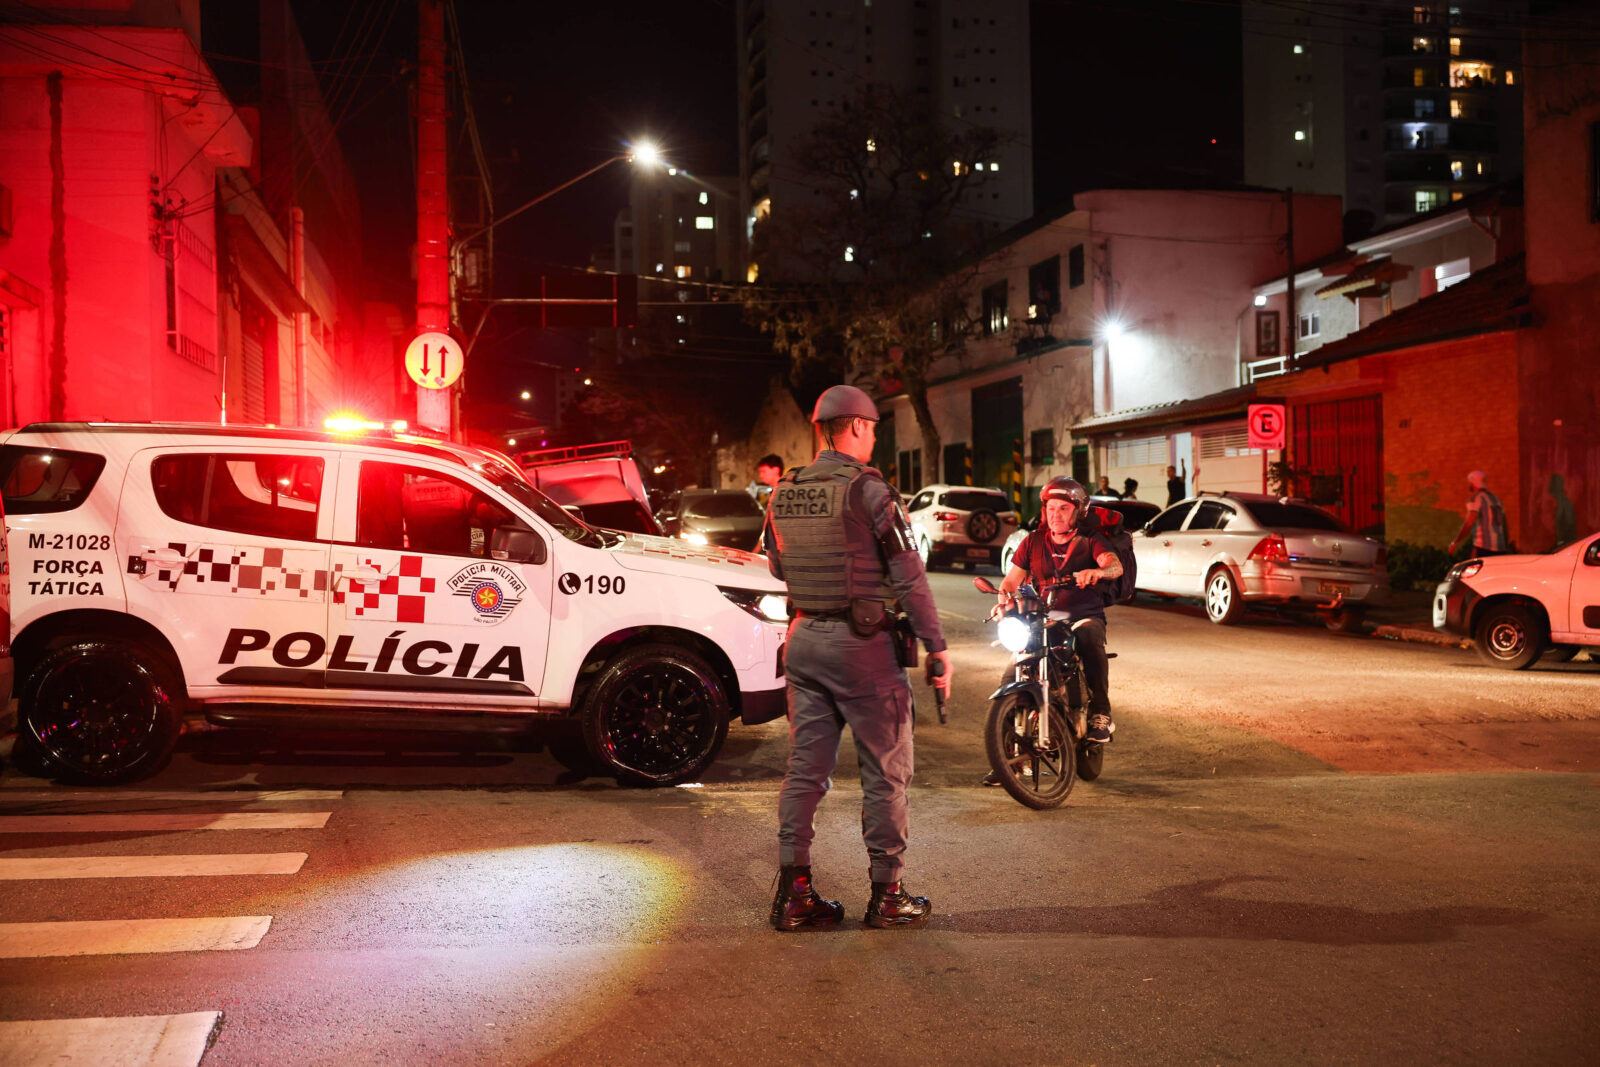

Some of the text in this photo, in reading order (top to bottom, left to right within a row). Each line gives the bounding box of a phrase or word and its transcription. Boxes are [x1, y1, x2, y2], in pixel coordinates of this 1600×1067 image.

[779, 488, 827, 501] FORÇA
[28, 533, 111, 550] M-21028
[33, 560, 104, 577] FORÇA
[28, 578, 104, 595] TÁTICA
[491, 565, 522, 592] MILITAR
[584, 574, 626, 595] 190
[217, 628, 526, 682] POLÍCIA
